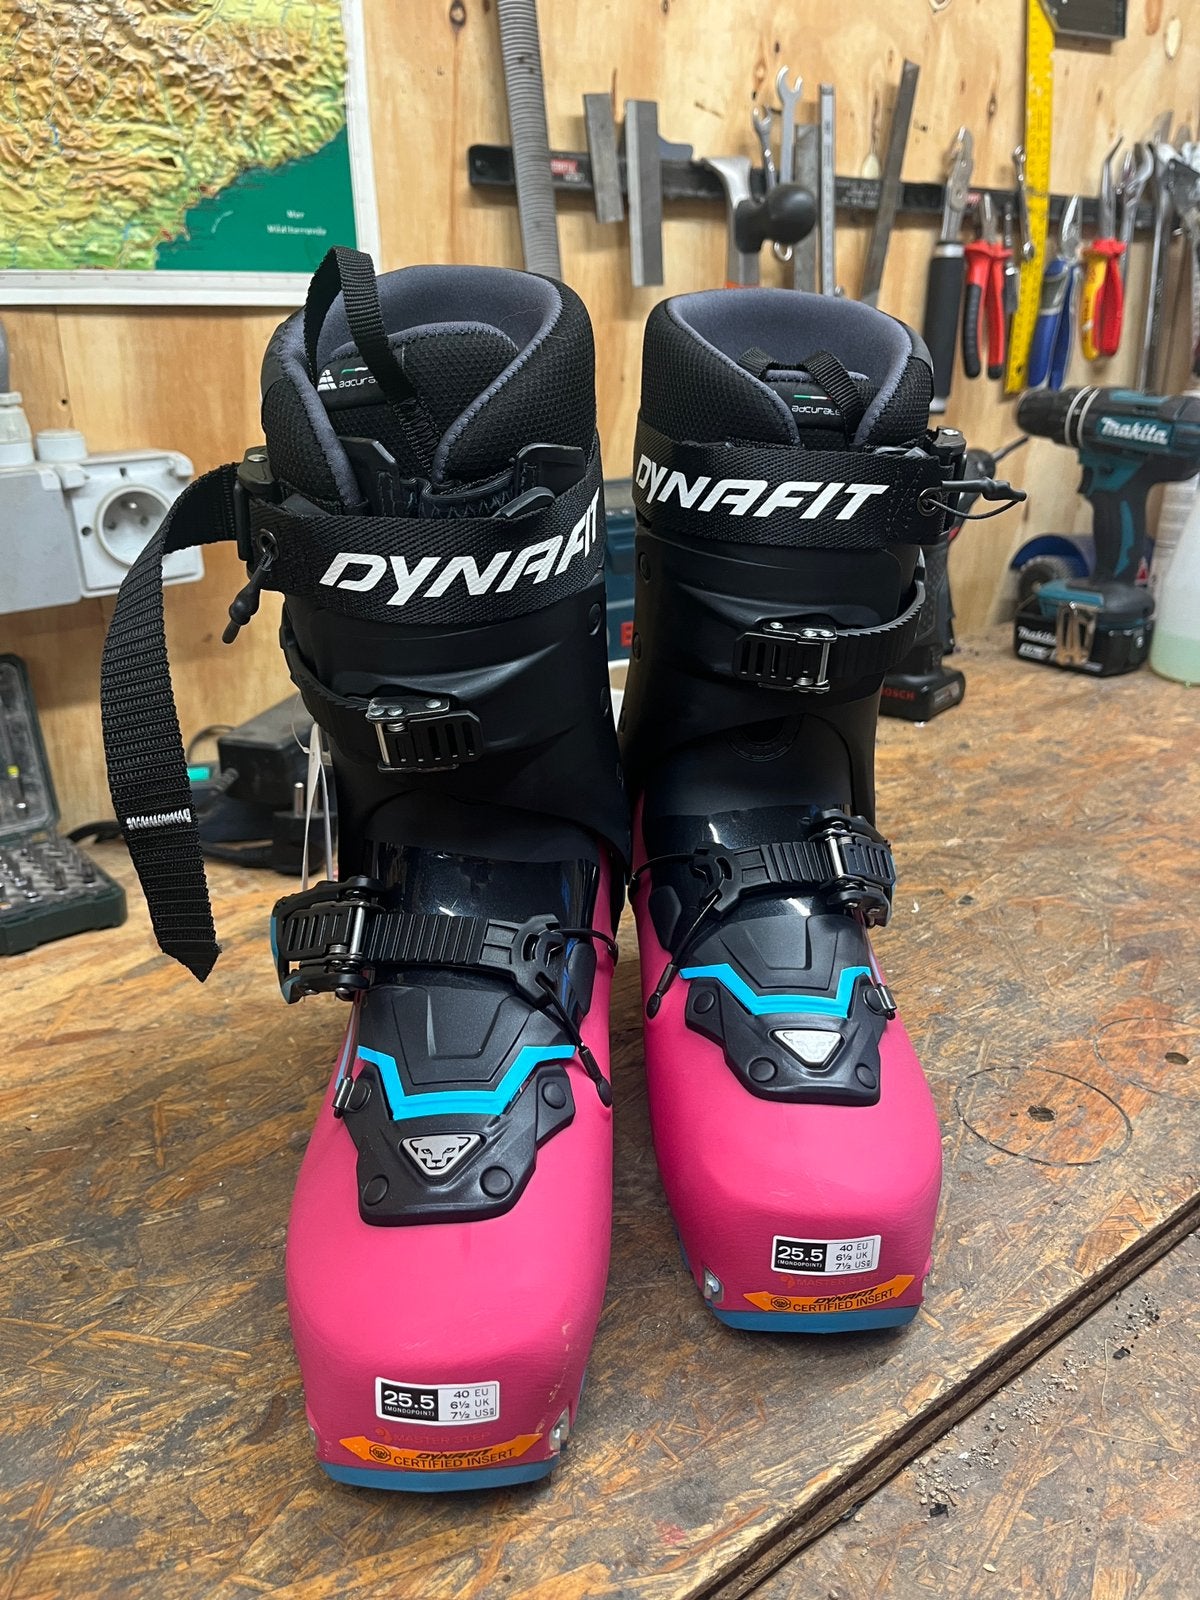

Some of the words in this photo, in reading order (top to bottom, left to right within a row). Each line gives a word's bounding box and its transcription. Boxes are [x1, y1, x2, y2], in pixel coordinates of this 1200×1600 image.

[338, 376, 378, 389] adcura
[636, 454, 890, 520] DYNAFIT
[319, 487, 600, 606] DYNAFIT
[777, 1245, 824, 1262] 25.5
[839, 1244, 854, 1252] 40
[856, 1242, 869, 1251] EU
[855, 1252, 868, 1260] UK
[777, 1259, 823, 1269] (MONDOPOINT)
[797, 1276, 846, 1288] MASTER
[793, 1299, 853, 1312] CERTIFIED
[856, 1287, 895, 1306] INSERT
[813, 1287, 878, 1304] DYNAFIT
[453, 1390, 470, 1398] 40
[474, 1388, 489, 1397] EU
[383, 1390, 435, 1410] 25.5
[474, 1398, 490, 1408] UK
[384, 1405, 435, 1417] (MONDOPOINT)
[394, 1433, 449, 1445] MASTER
[453, 1431, 492, 1444] STEP
[393, 1456, 463, 1469] CERTIFIED
[466, 1447, 515, 1466] INSERT
[415, 1447, 493, 1459] DYNAFIT
